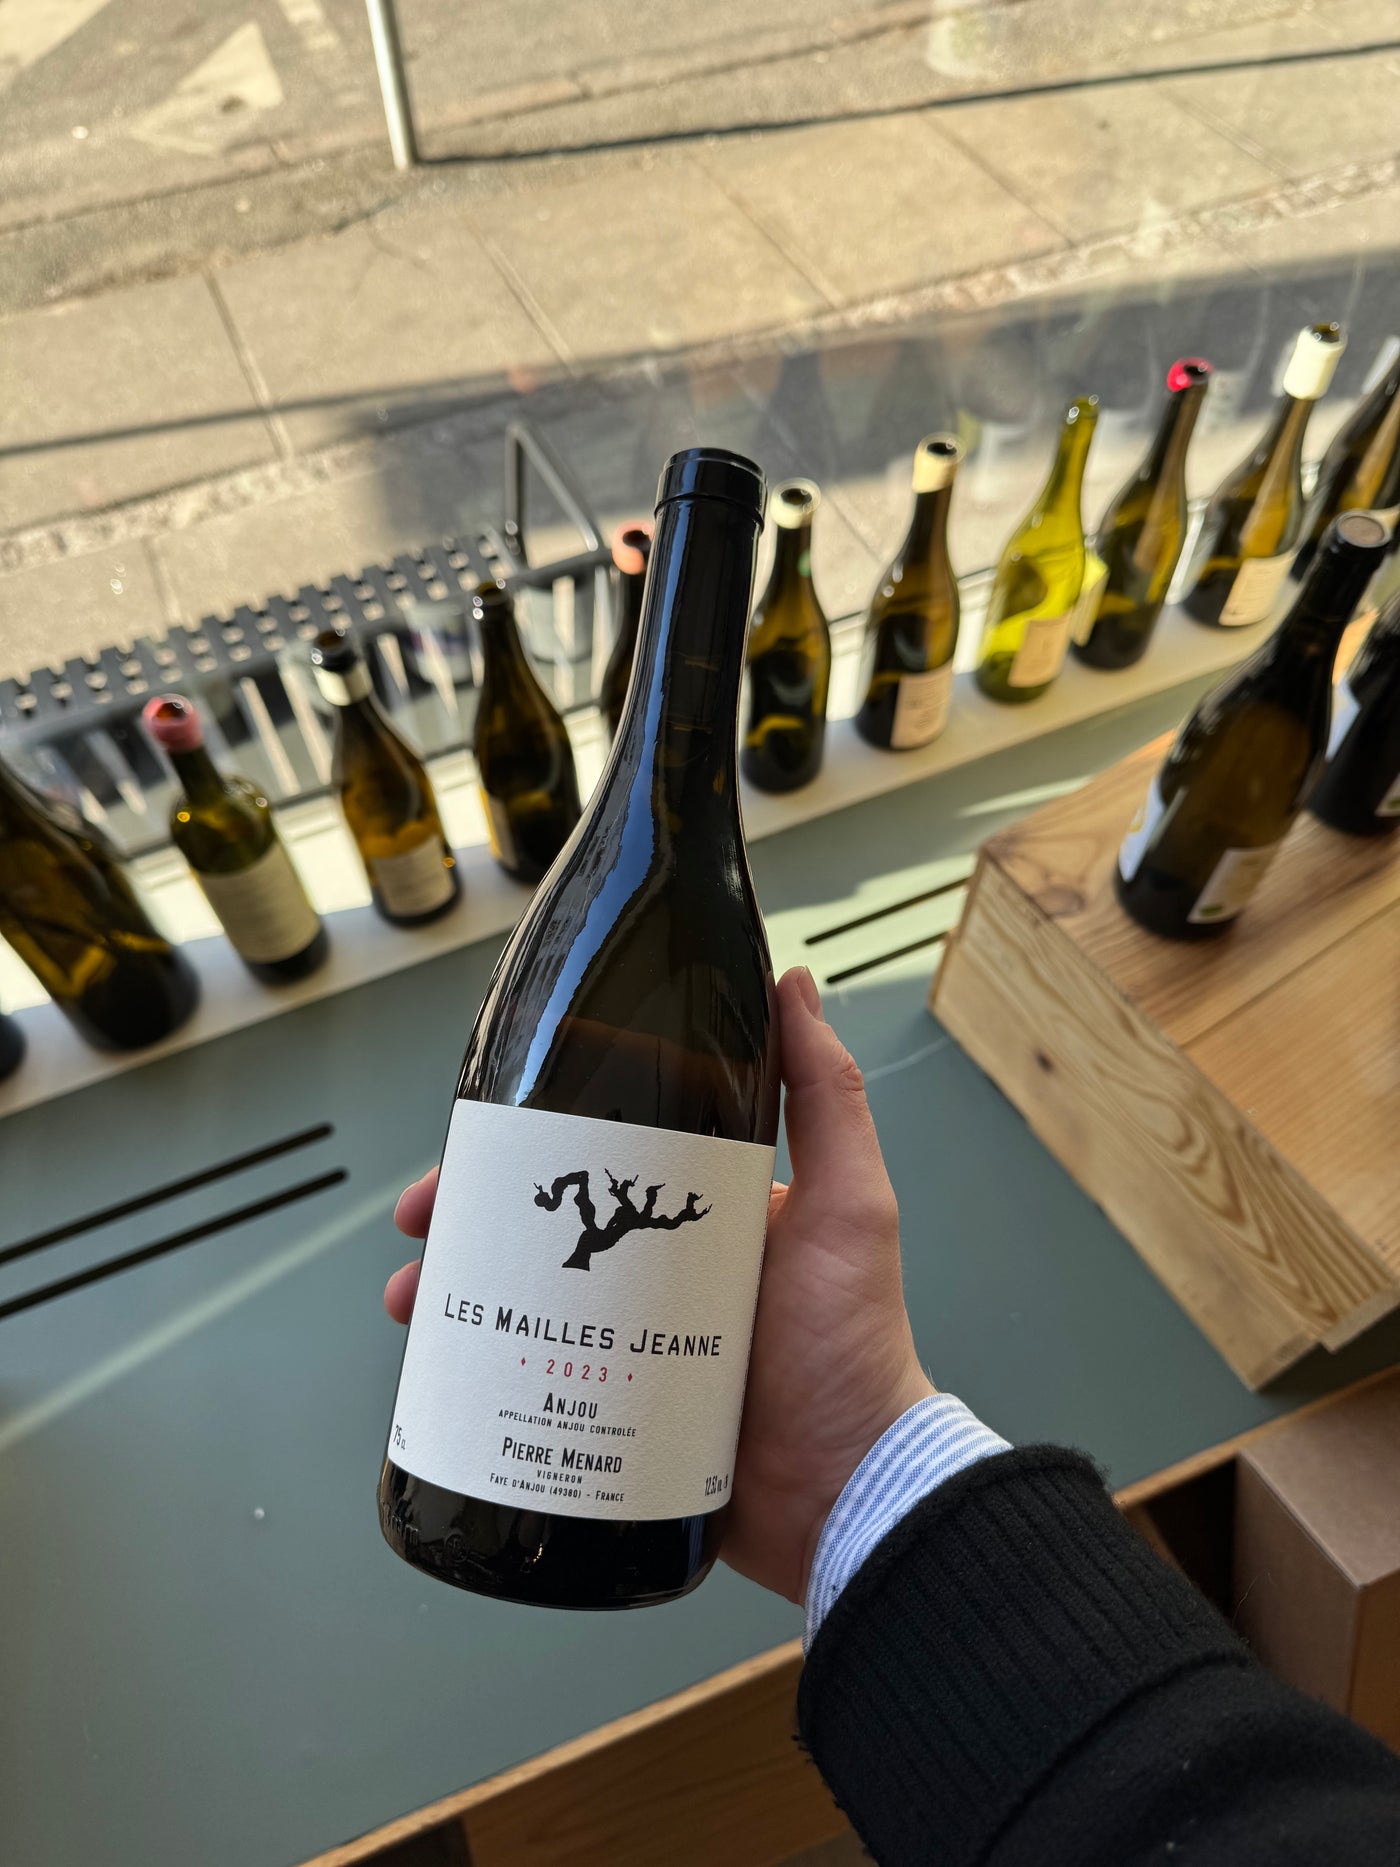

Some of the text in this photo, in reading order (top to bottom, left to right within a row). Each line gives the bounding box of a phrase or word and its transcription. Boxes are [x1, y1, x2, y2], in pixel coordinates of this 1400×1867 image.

[443, 1292, 723, 1357] LES MAILLES JEANNE
[545, 1359, 608, 1383] 2023
[543, 1392, 598, 1419] ANJOU
[498, 1408, 553, 1428] APPELLATION
[556, 1420, 586, 1433] ANJOU
[502, 1436, 623, 1474] PIERRE MENARD
[489, 1472, 509, 1487] FAYE
[511, 1479, 546, 1494] D'ANJOU
[595, 1490, 625, 1502] FRANCE
[536, 1469, 583, 1485] VIGNERON
